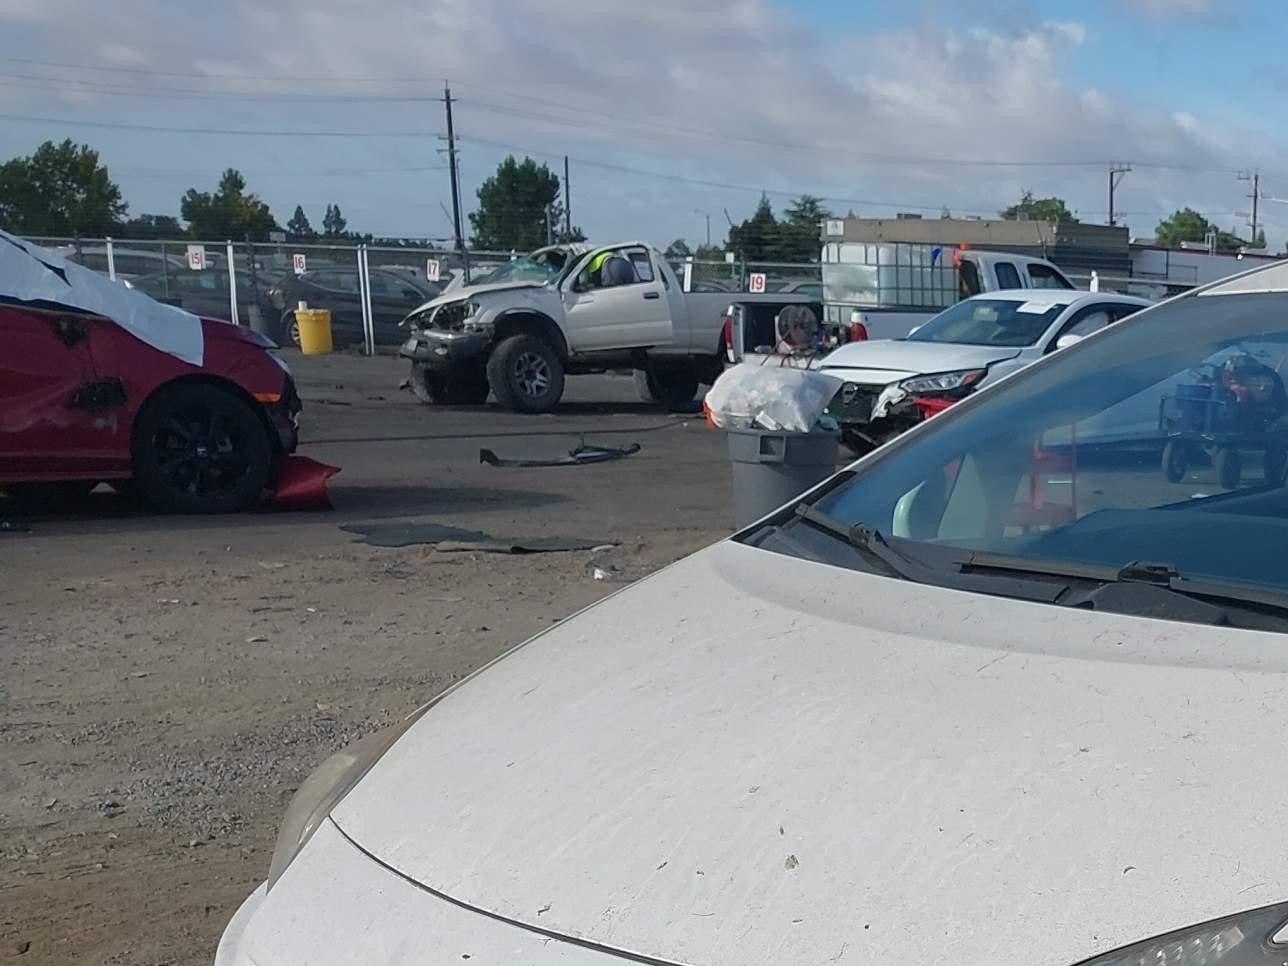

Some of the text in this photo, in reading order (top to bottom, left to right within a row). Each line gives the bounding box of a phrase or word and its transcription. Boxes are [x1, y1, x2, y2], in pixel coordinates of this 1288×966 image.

[294, 256, 304, 269] 16
[428, 262, 437, 275] 17
[751, 275, 764, 290] 19
